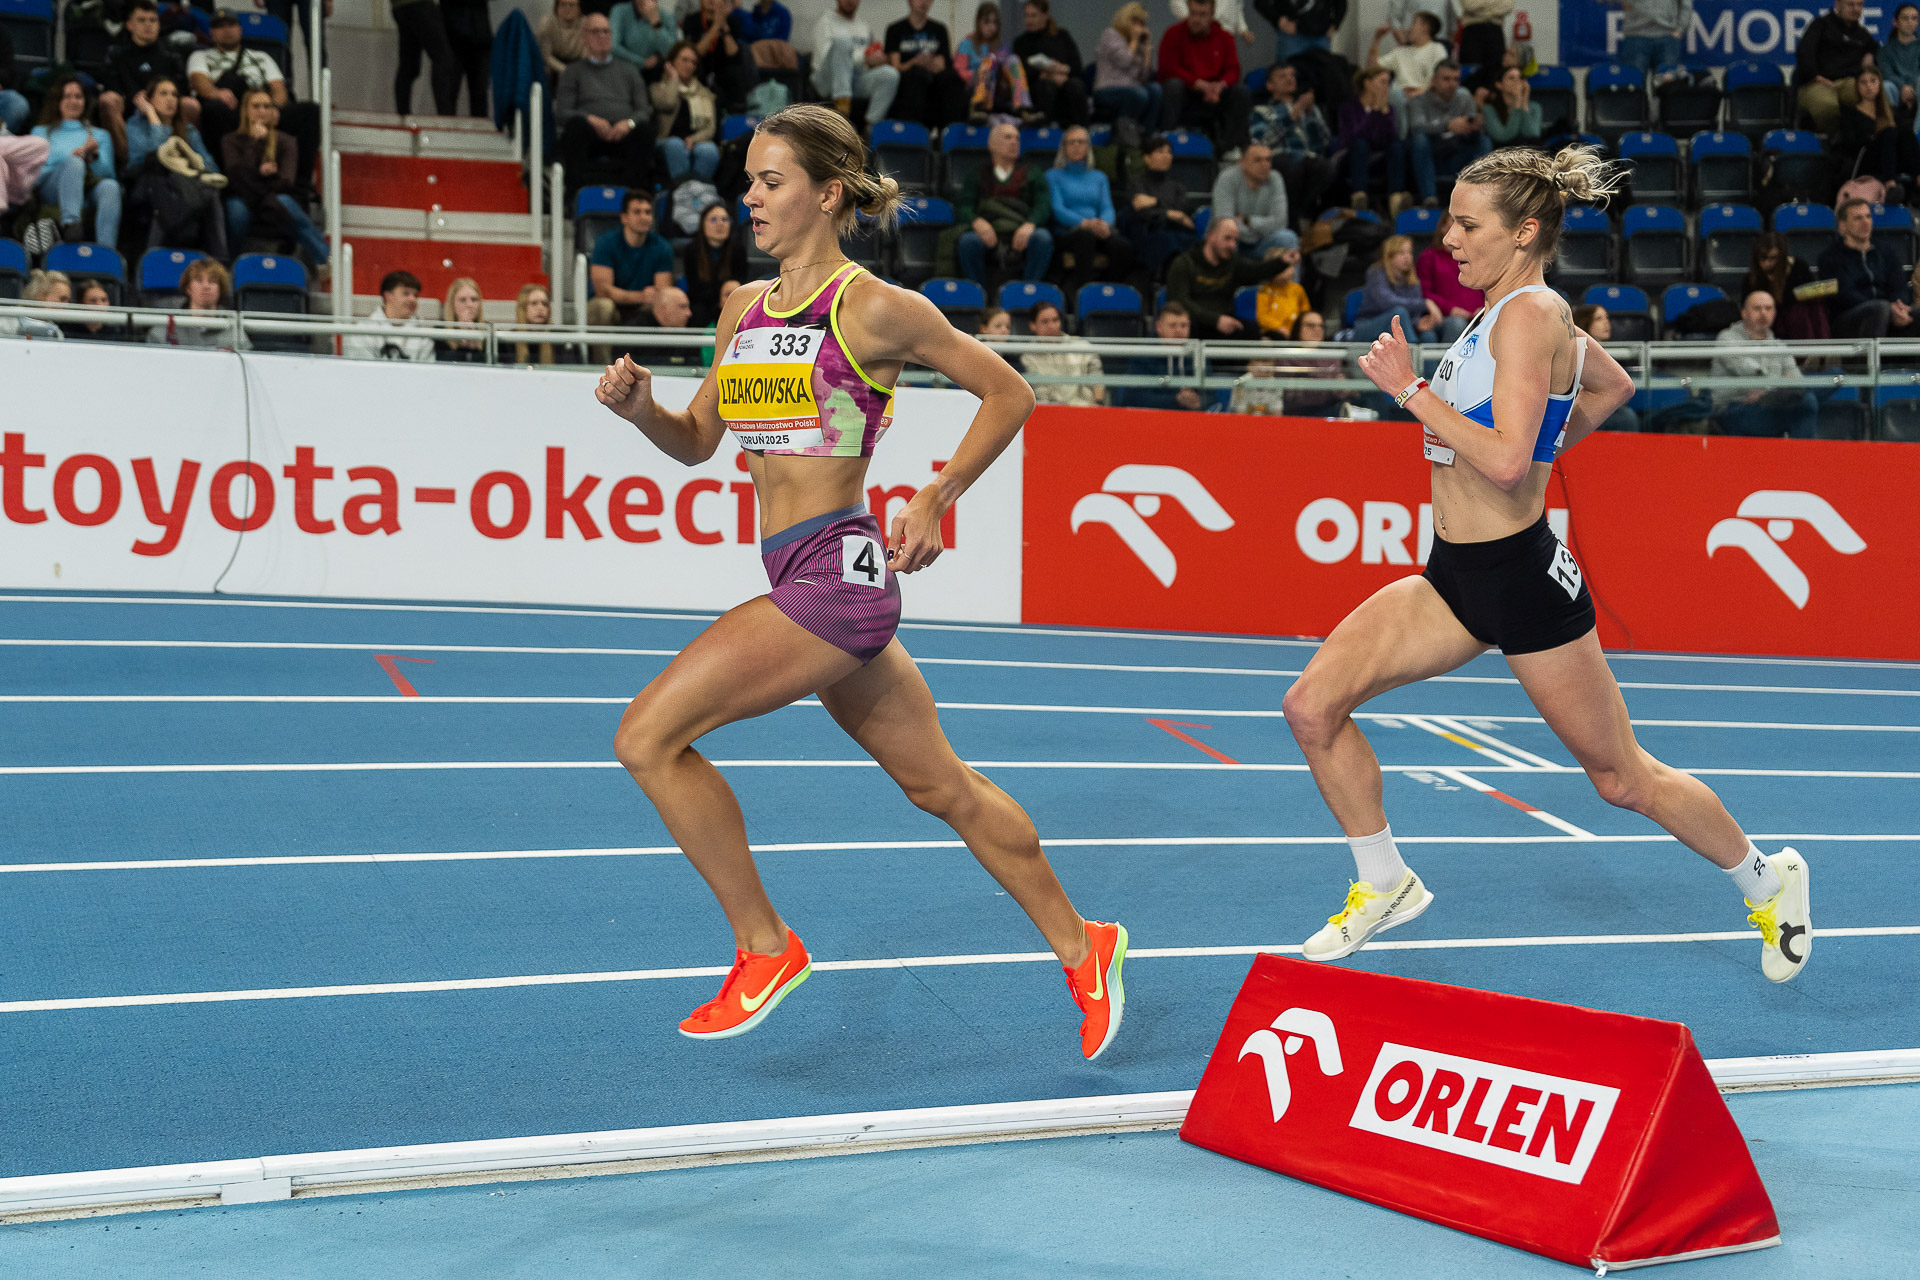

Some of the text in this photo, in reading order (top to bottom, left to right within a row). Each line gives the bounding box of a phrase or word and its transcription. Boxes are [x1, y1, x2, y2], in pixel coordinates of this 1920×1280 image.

[1606, 8, 1884, 54] PMORE
[769, 333, 811, 356] 333
[720, 377, 811, 405] LIZAKOWSKA
[740, 433, 790, 445] TORUŃ 2025
[756, 421, 794, 430] Mistrzostwa
[794, 418, 816, 428] Polski
[852, 541, 879, 583] 4
[1556, 549, 1578, 589] 13
[1390, 876, 1417, 910] RUNNING
[1374, 1060, 1596, 1165] ORLEN
